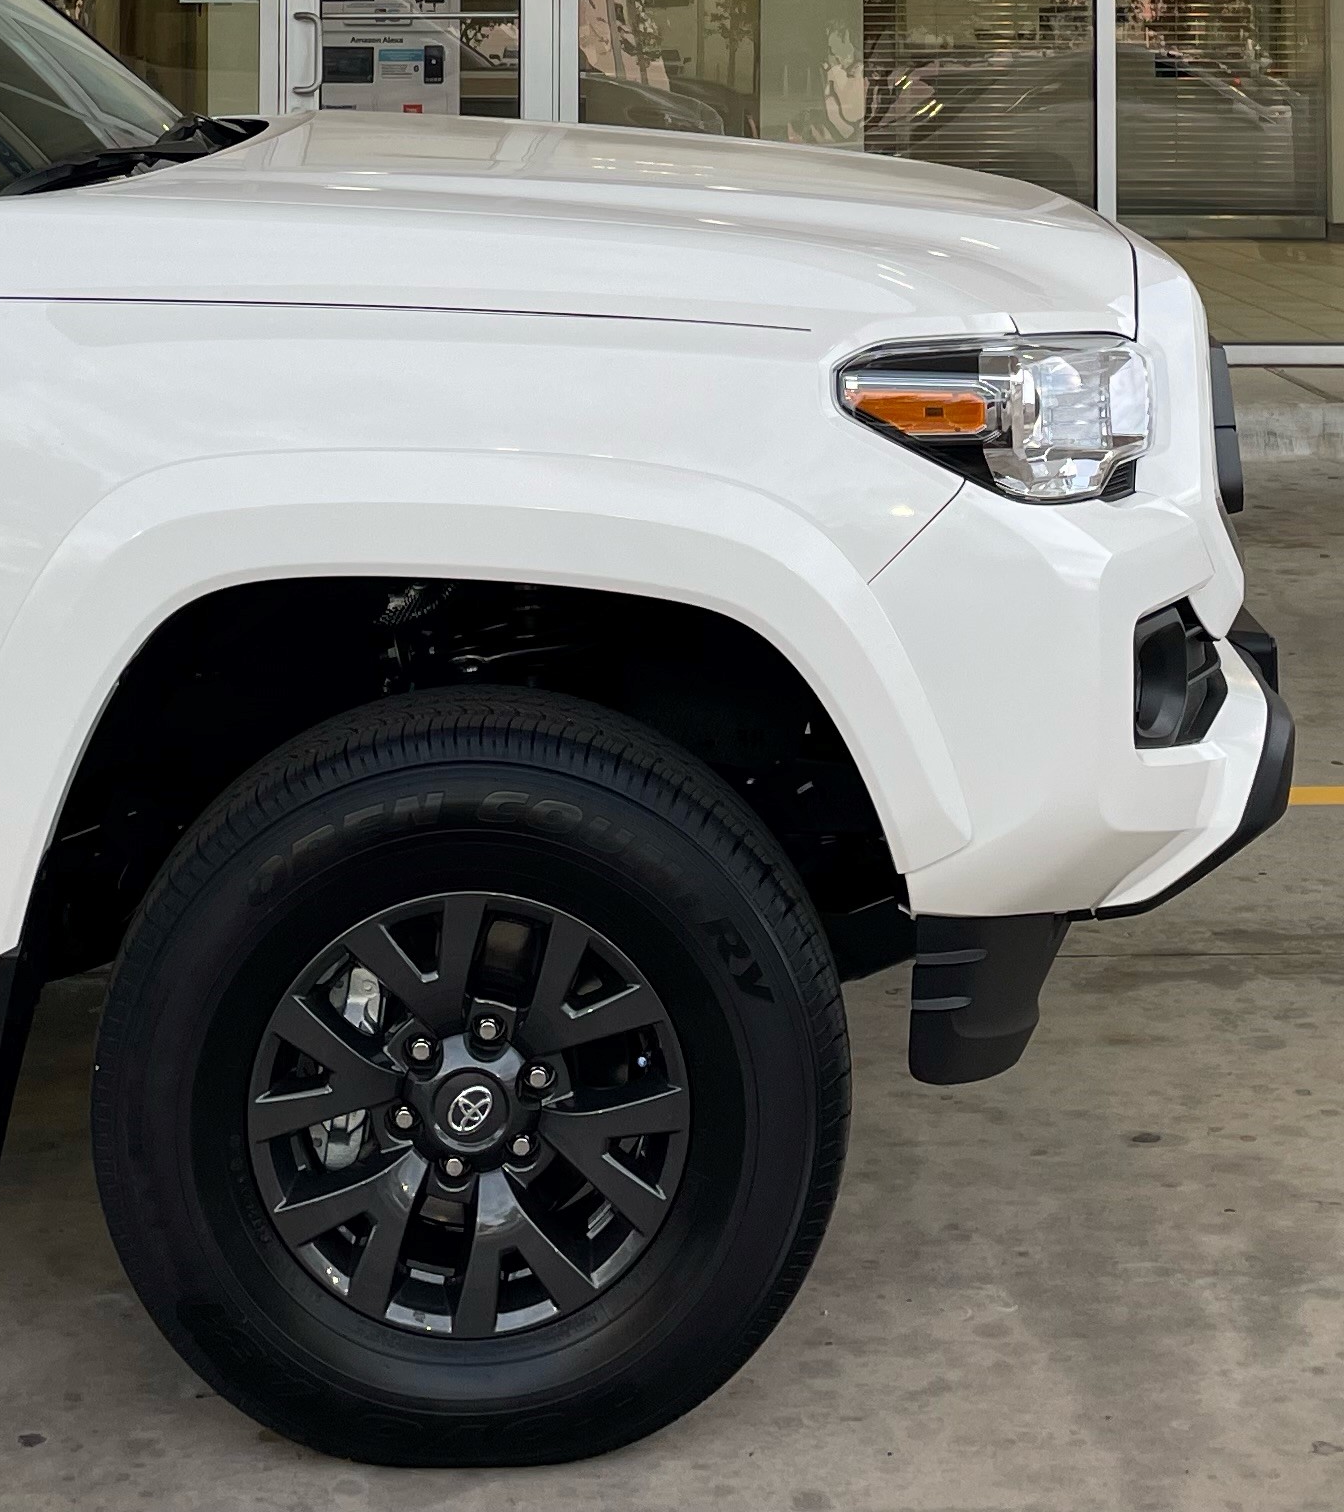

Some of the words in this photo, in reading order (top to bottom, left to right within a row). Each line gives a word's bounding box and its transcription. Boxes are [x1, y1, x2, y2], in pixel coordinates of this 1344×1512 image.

[350, 36, 381, 44] Amazon
[382, 36, 404, 44] Alexa
[476, 789, 776, 1005] COUNRY
